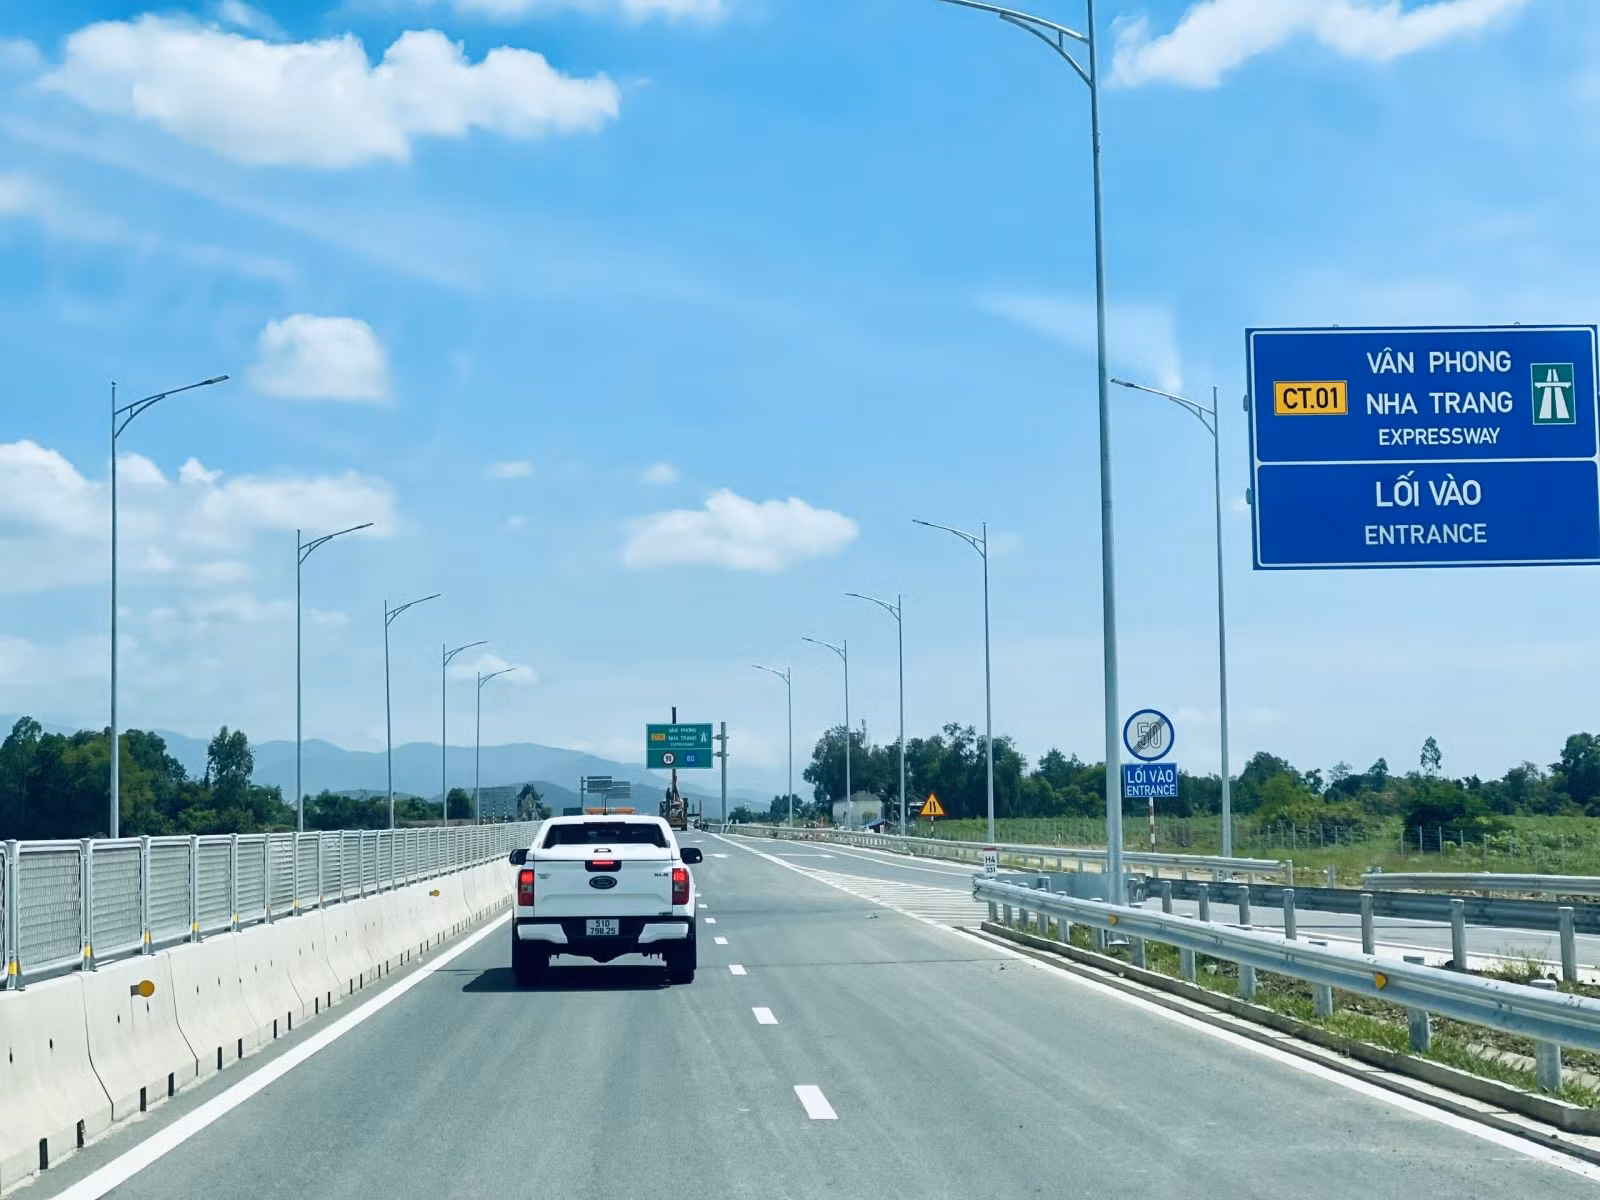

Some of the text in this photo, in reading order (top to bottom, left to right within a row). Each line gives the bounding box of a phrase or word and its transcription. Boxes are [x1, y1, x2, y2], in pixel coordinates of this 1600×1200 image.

[1366, 347, 1512, 374] VÂN PHONG
[1282, 386, 1340, 409] CT.01
[1367, 391, 1513, 415] NHA TRANG
[1378, 427, 1501, 446] EXPRESSWAY
[1375, 470, 1482, 507] LỐI VÀO
[1365, 523, 1488, 545] ENTRANCE
[1137, 722, 1162, 749] 50
[1127, 765, 1174, 783] LỐI VÀO
[1127, 784, 1175, 796] ENTRANCE
